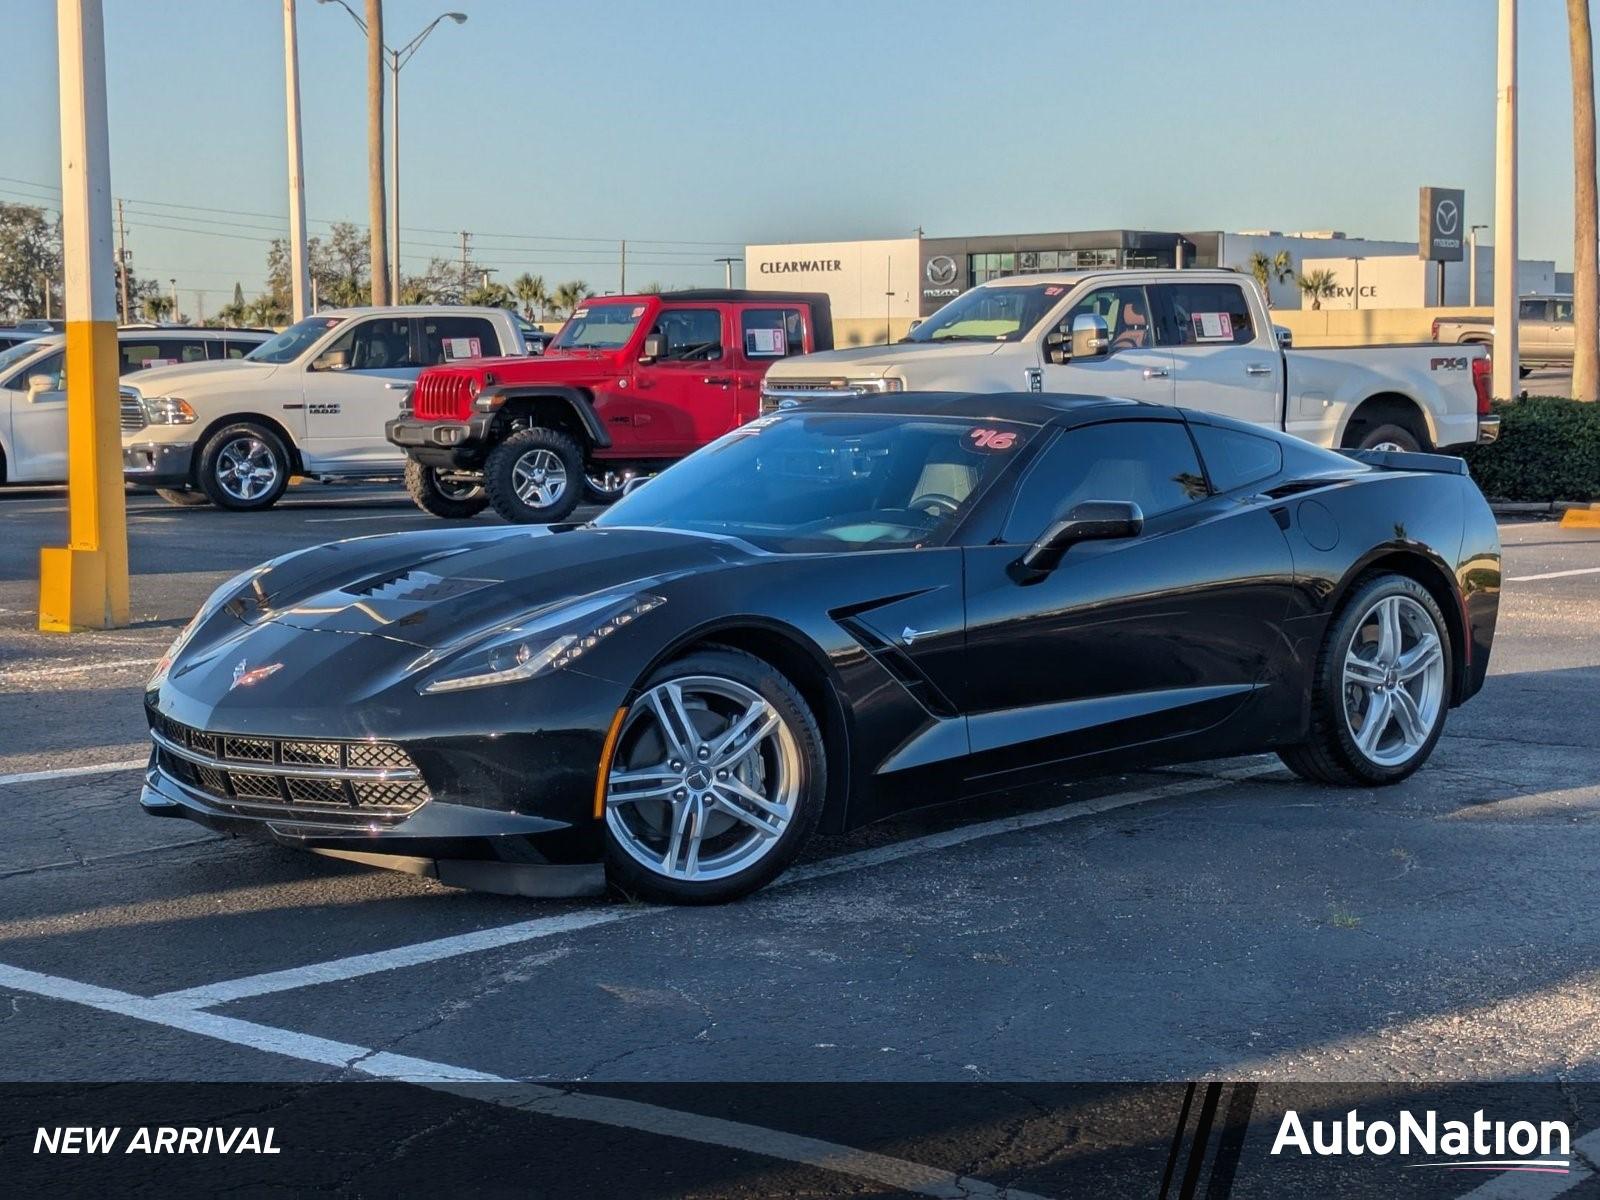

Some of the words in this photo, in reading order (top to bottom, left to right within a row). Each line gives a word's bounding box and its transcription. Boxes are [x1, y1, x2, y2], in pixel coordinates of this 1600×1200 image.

[1433, 238, 1460, 248] mazda
[760, 260, 842, 274] CLEARWATER
[923, 288, 960, 297] mazda
[1430, 357, 1468, 371] FX4
